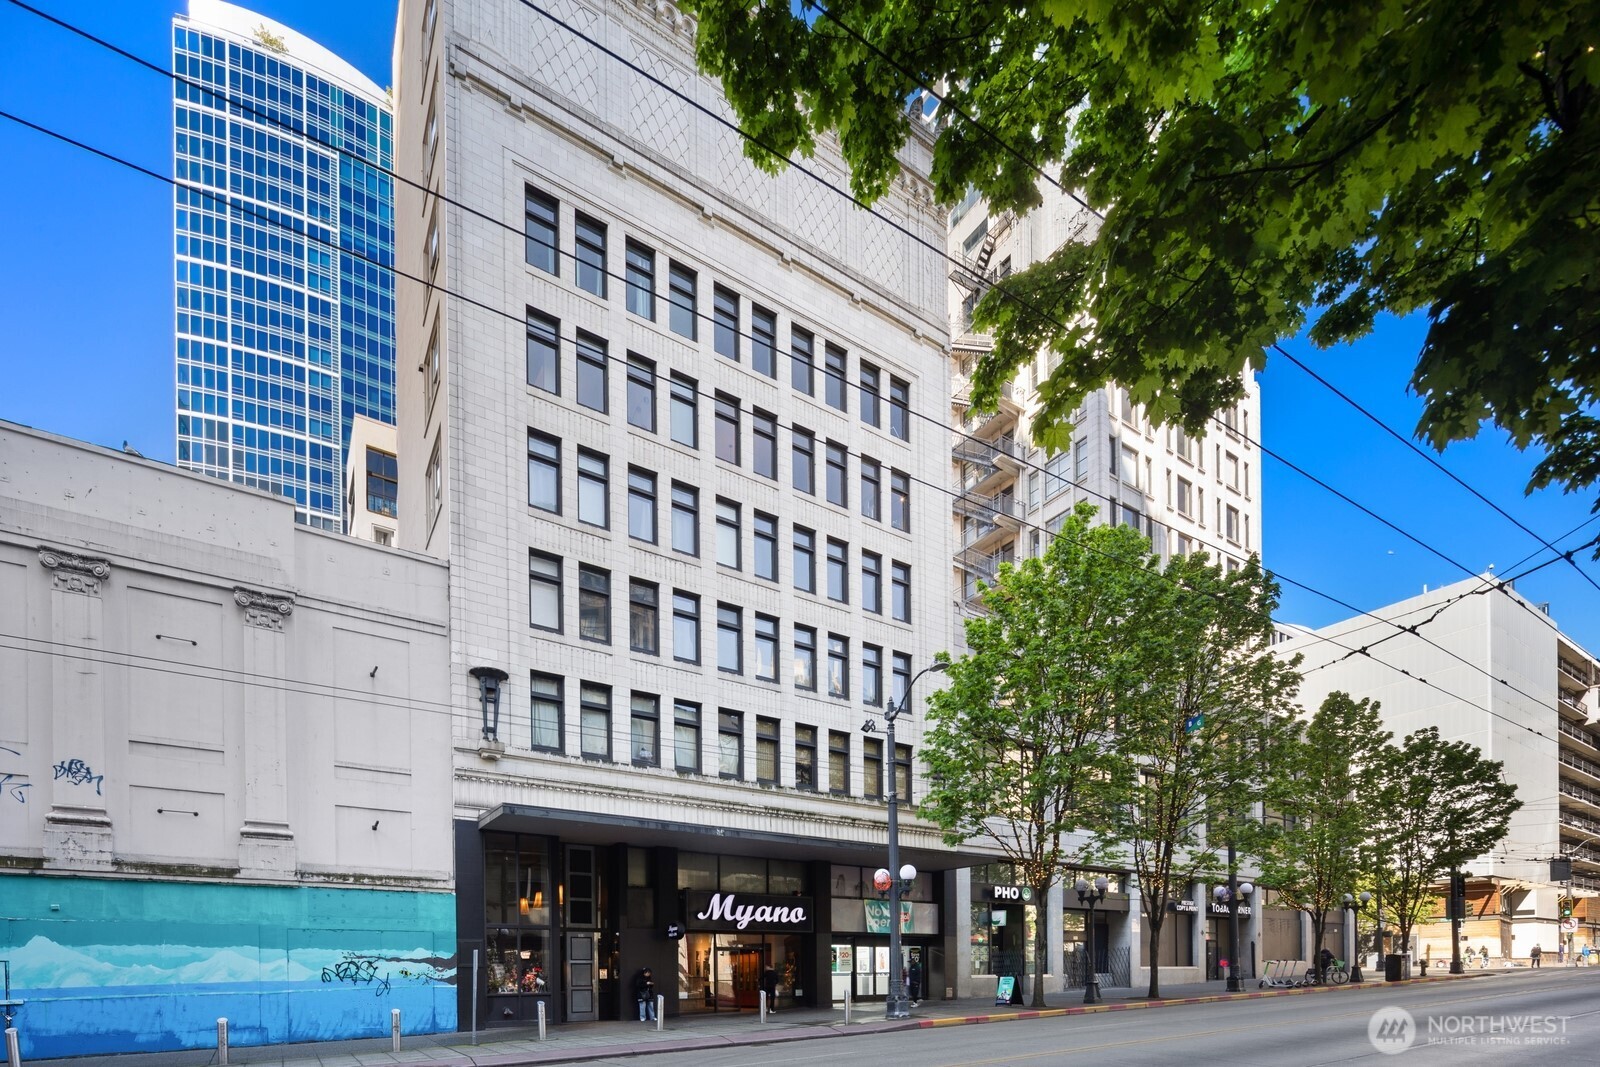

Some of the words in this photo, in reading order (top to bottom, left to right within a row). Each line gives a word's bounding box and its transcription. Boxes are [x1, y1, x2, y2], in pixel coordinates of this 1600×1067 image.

[994, 886, 1019, 900] PHO
[697, 893, 806, 930] Myano
[1238, 906, 1251, 914] RNER
